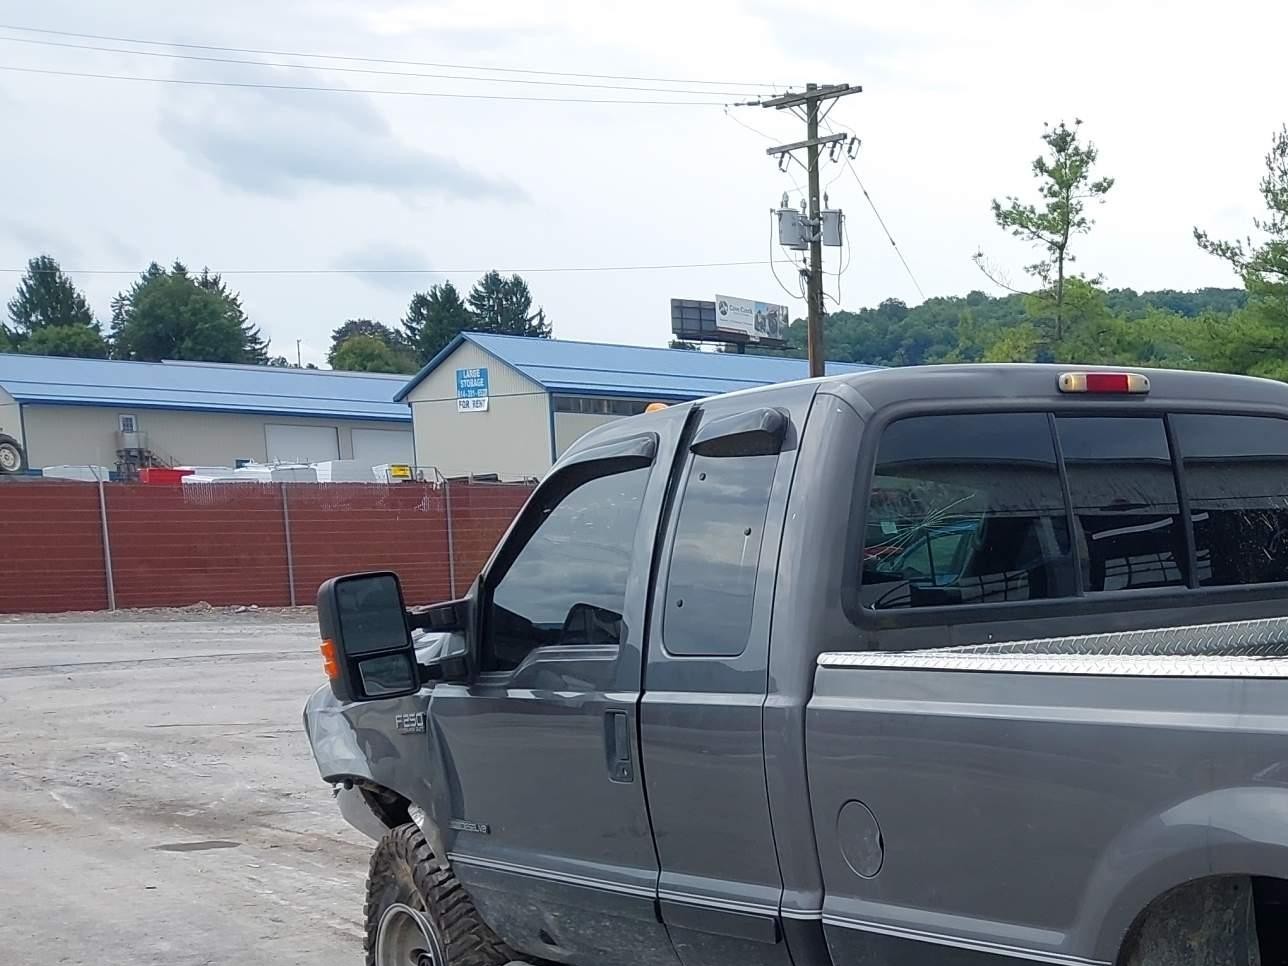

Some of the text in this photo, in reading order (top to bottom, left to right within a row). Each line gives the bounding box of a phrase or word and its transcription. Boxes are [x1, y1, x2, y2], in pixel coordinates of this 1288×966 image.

[463, 369, 480, 378] LARGE
[460, 378, 484, 388] STORAGE
[459, 399, 470, 409] FOR
[472, 399, 486, 408] RENT
